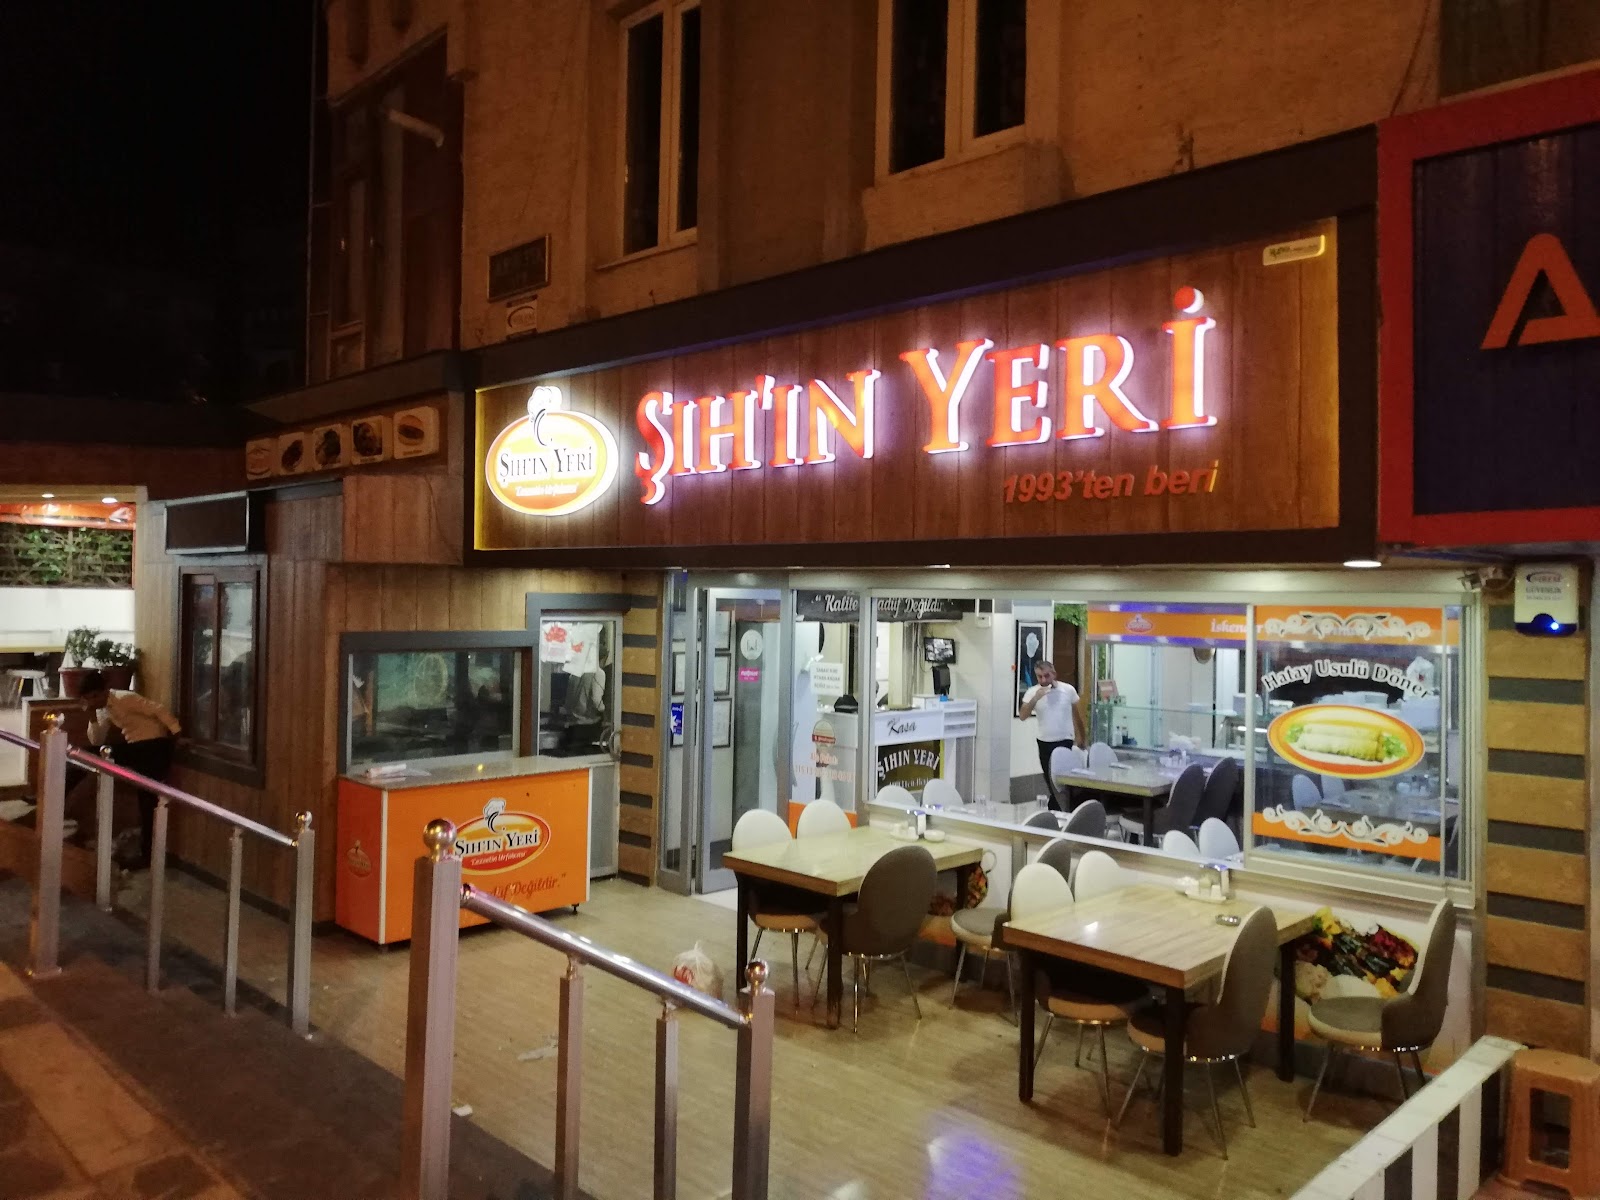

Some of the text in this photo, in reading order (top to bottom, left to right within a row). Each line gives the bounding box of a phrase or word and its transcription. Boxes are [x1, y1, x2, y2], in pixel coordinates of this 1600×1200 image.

[899, 286, 1217, 454] YERİ
[1003, 459, 1219, 504] 1993'ten beri
[1262, 658, 1431, 699] Hatay Usulü Döner
[507, 829, 539, 847] YERİ
